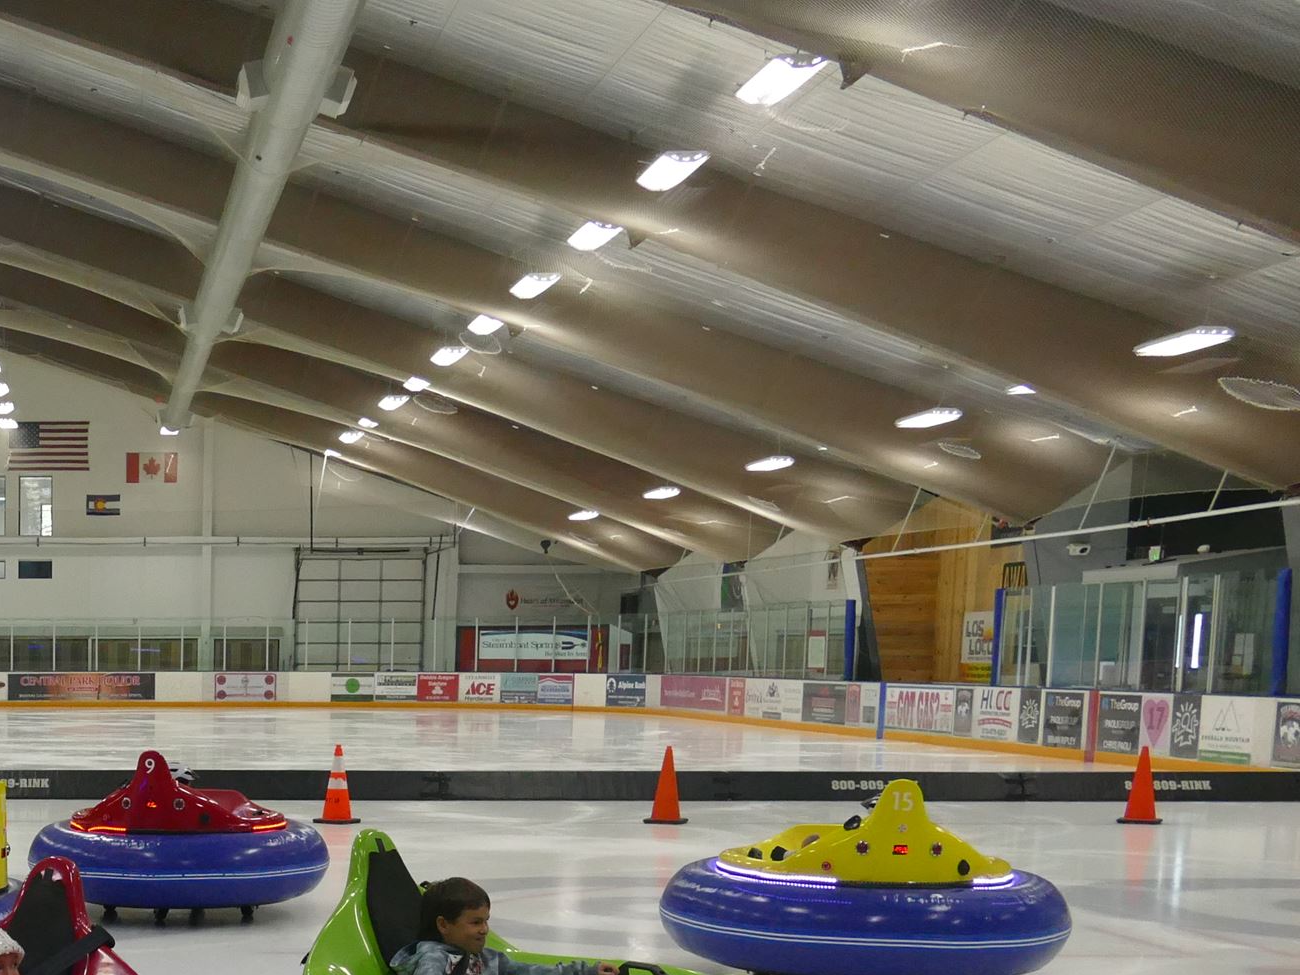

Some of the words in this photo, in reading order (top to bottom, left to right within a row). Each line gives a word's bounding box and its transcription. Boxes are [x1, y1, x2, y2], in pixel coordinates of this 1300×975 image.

[965, 620, 985, 638] LOS
[482, 641, 530, 649] Steamboat
[531, 641, 561, 651] Springs
[19, 675, 66, 686] CENTRAL
[69, 676, 95, 686] PARK
[617, 680, 634, 690] Alpine
[465, 681, 496, 696] ACE
[1055, 695, 1082, 708] TheGroup
[1110, 698, 1139, 712] TheGroup
[897, 690, 916, 728] GOT
[917, 691, 940, 730] GAS?
[1147, 706, 1166, 731] 17
[144, 758, 156, 774] 9
[1124, 780, 1212, 790] 8809-RINK
[891, 790, 914, 811] 15
